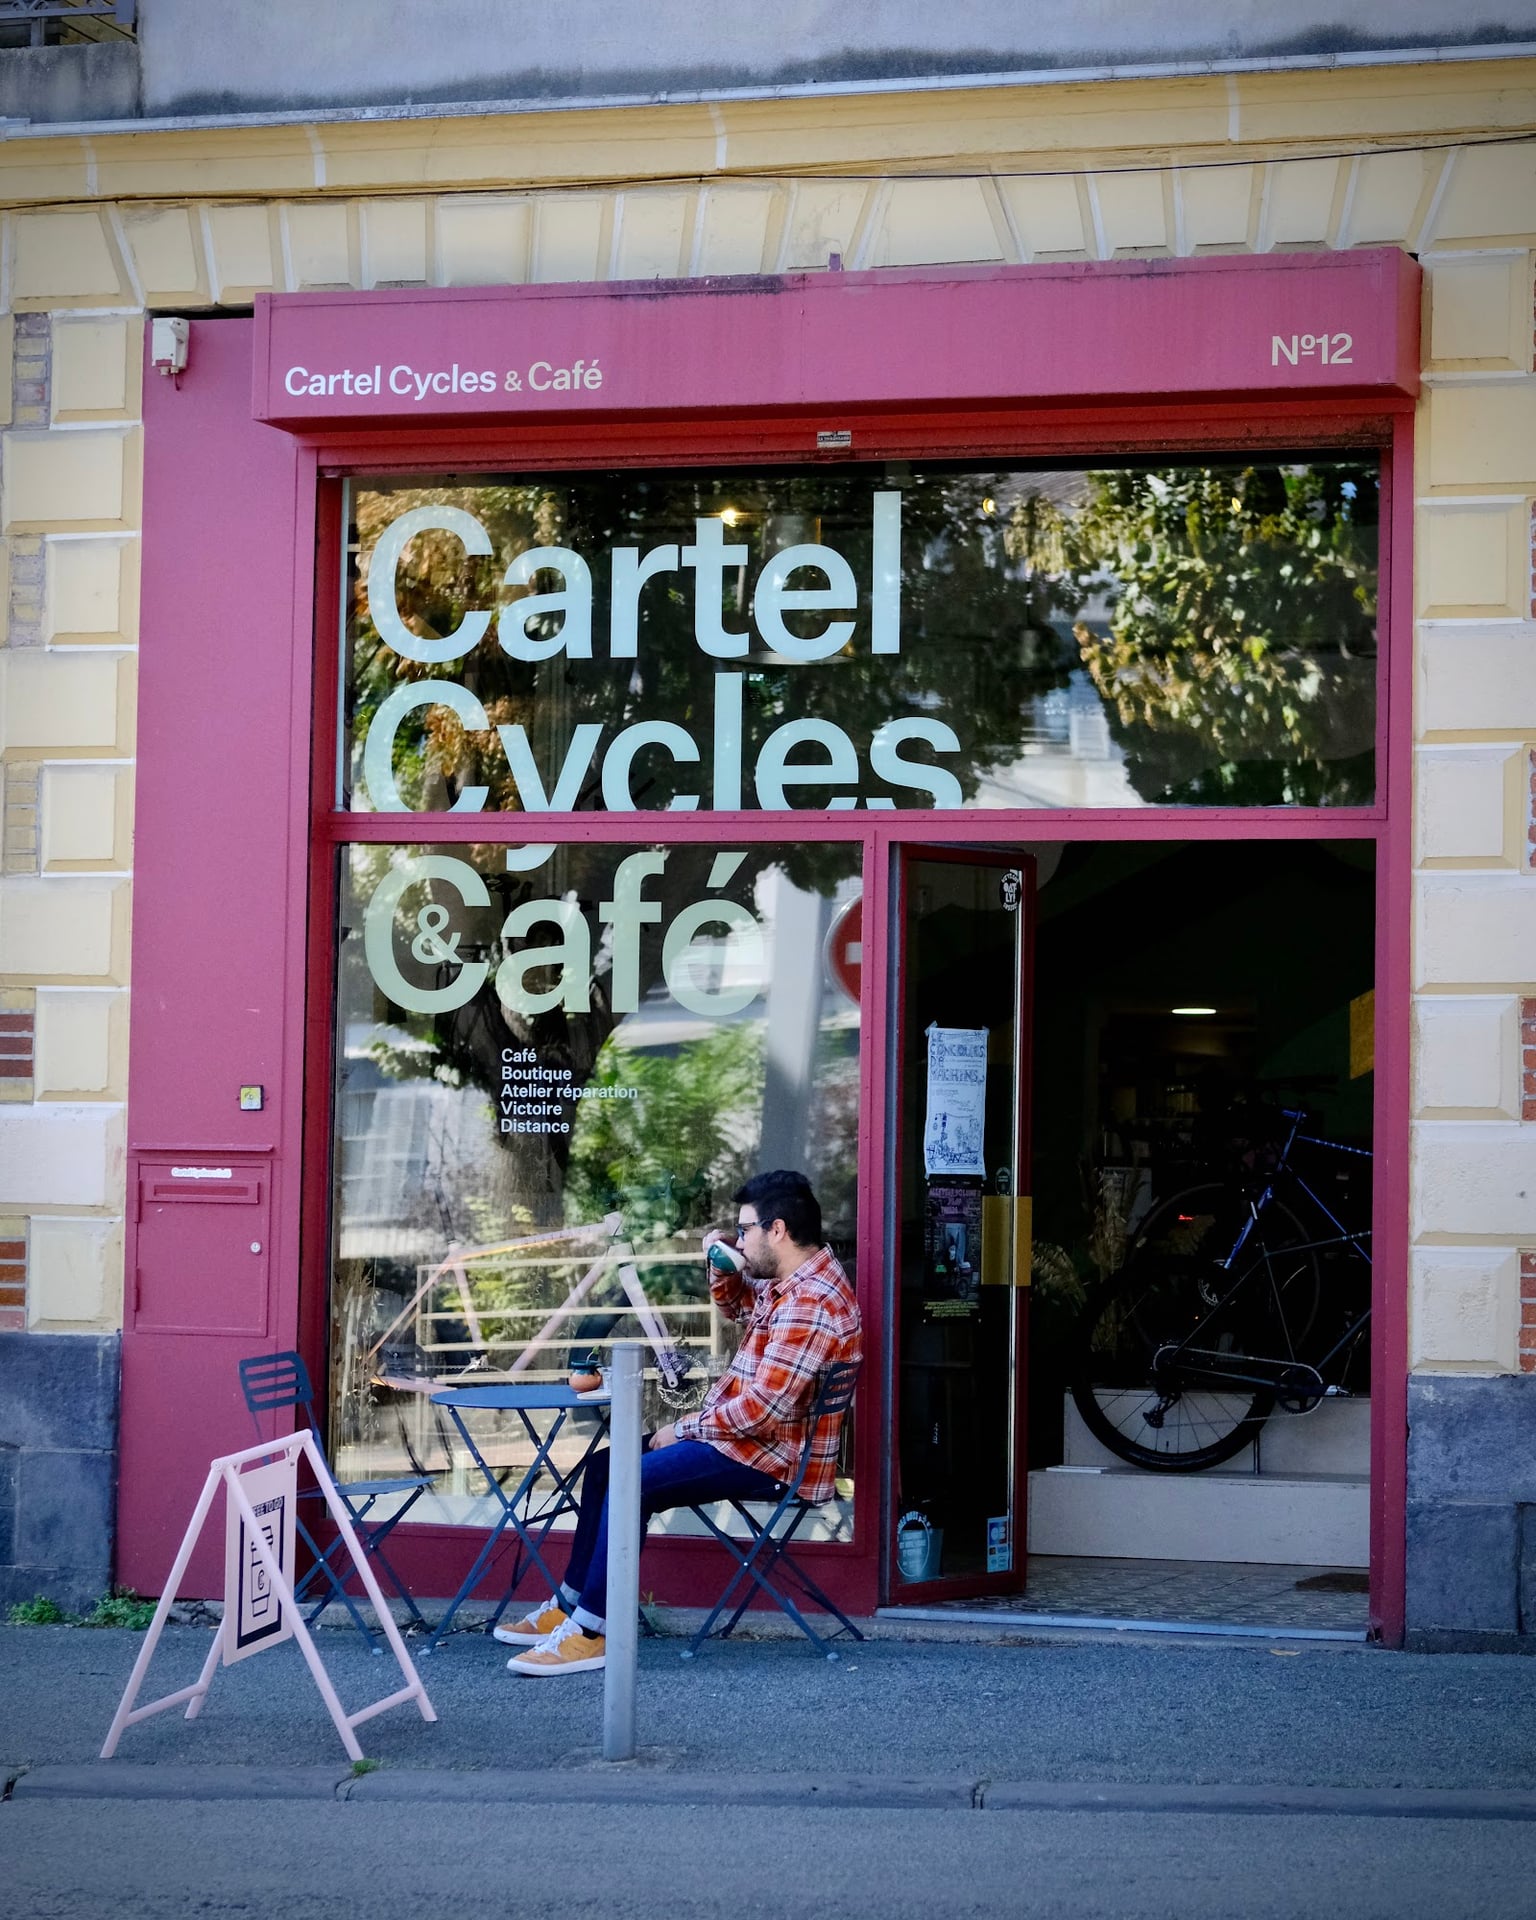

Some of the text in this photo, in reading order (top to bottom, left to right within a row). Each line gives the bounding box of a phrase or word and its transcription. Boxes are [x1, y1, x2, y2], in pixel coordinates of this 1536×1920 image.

[284, 359, 603, 401] Cartel Cycles & Café
[367, 490, 902, 663] Cartel
[364, 672, 964, 872] Cycles
[364, 851, 764, 1017] & Café
[501, 1047, 537, 1063] Café
[501, 1065, 573, 1084] Boutique
[500, 1083, 639, 1101] Atelier réparation
[500, 1100, 563, 1116] Victoire
[500, 1118, 570, 1134] Distance
